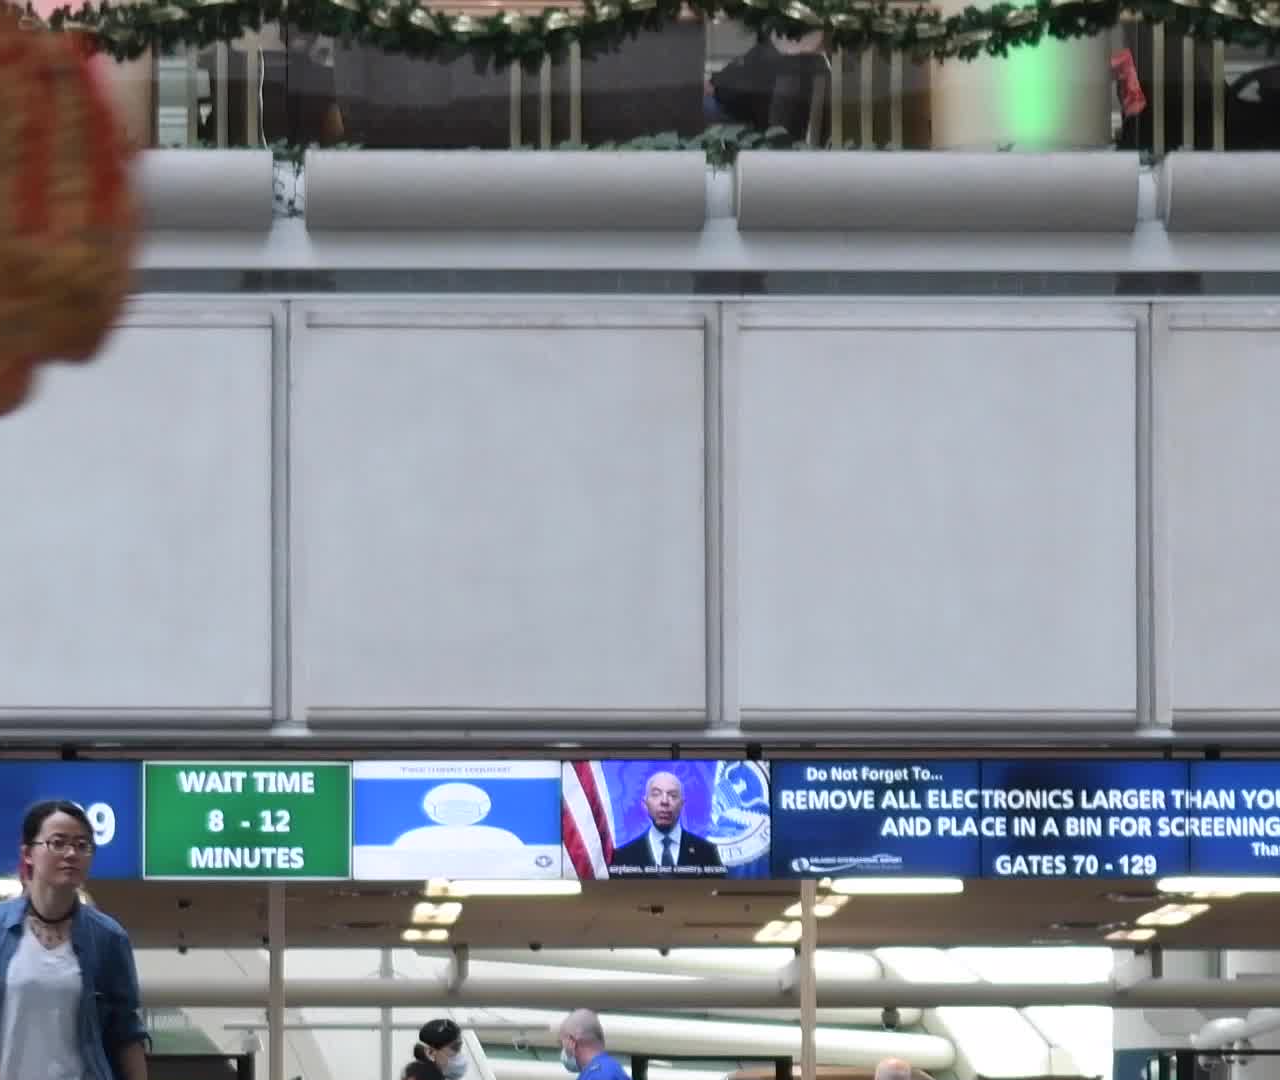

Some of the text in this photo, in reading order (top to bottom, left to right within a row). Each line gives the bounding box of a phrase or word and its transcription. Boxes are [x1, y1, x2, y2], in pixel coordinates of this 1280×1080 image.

[179, 771, 315, 793] WAIT TIME
[807, 767, 827, 781] Do
[831, 767, 857, 781] Not
[861, 767, 908, 784] Forget
[781, 790, 875, 810] REMOVE
[881, 790, 922, 809] ALL
[928, 789, 1074, 810] ELECTRONICS
[1081, 789, 1166, 810] LARGER
[1171, 789, 1235, 809] THAN
[208, 809, 224, 832] 8
[260, 809, 291, 832] 12
[881, 816, 1280, 837] AND PLACE IN A BIN FOR SCREENING
[189, 847, 304, 869] MINUTES
[995, 855, 1066, 875] GATES
[1072, 855, 1099, 875] 70
[1118, 854, 1157, 875] 129
